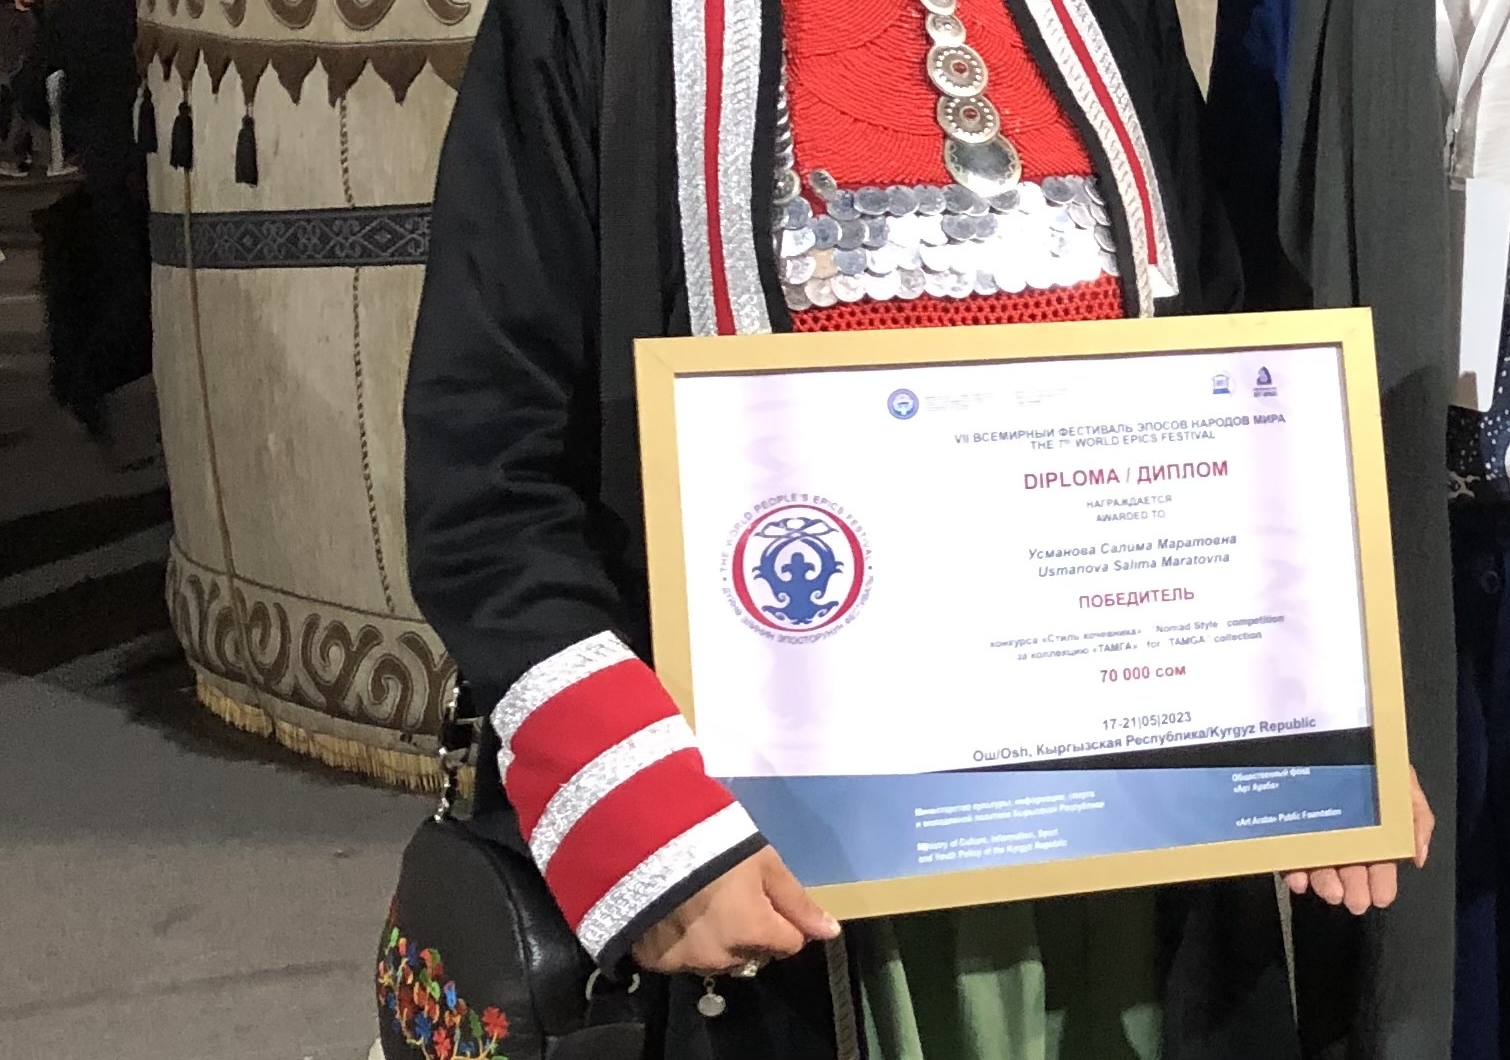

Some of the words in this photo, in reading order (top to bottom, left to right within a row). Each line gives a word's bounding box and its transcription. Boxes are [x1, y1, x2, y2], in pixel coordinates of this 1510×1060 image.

[954, 434, 969, 443] VII
[1058, 424, 1133, 437] ФЕСТИВАЛЬ
[1137, 419, 1188, 432] ЭПОСОВ
[1191, 416, 1250, 428] НАРОДОВ
[1253, 414, 1286, 425] МИРА
[1030, 440, 1054, 450] THE
[1075, 436, 1120, 448] WORLD
[1123, 434, 1158, 445] EPICS
[1161, 430, 1216, 442] FESTIVAL
[1024, 468, 1121, 490] DIPLOMA
[1137, 460, 1228, 484] ДИПЛОМ
[1086, 494, 1172, 508] НАГРАЖДАЕТСЯ
[1096, 511, 1148, 522] AWARDED
[1151, 510, 1165, 518] TO
[1028, 546, 1096, 560] Усманова
[1101, 542, 1152, 554] Салима
[1157, 535, 1237, 550] Маратовна
[1038, 563, 1109, 577] Usmanova
[1114, 559, 1156, 571] Salima
[1161, 553, 1230, 567] Maratovna
[1079, 588, 1195, 609] ПОБЕДИТЕЛЬ
[990, 638, 1038, 648] конкурса
[1227, 615, 1284, 627] competition
[1093, 642, 1138, 652] «ТАМГА»
[1214, 632, 1262, 643] collection
[1100, 669, 1118, 683] 70
[1123, 666, 1150, 681] 000
[1155, 666, 1186, 677] сом
[1103, 711, 1192, 730] 17-21|05|2023
[973, 747, 1032, 762] Ош/Osh,
[1036, 737, 1122, 756] Кыргызская
[1126, 724, 1255, 746] Республика/Kyrgyz
[1259, 716, 1316, 733] Republic
